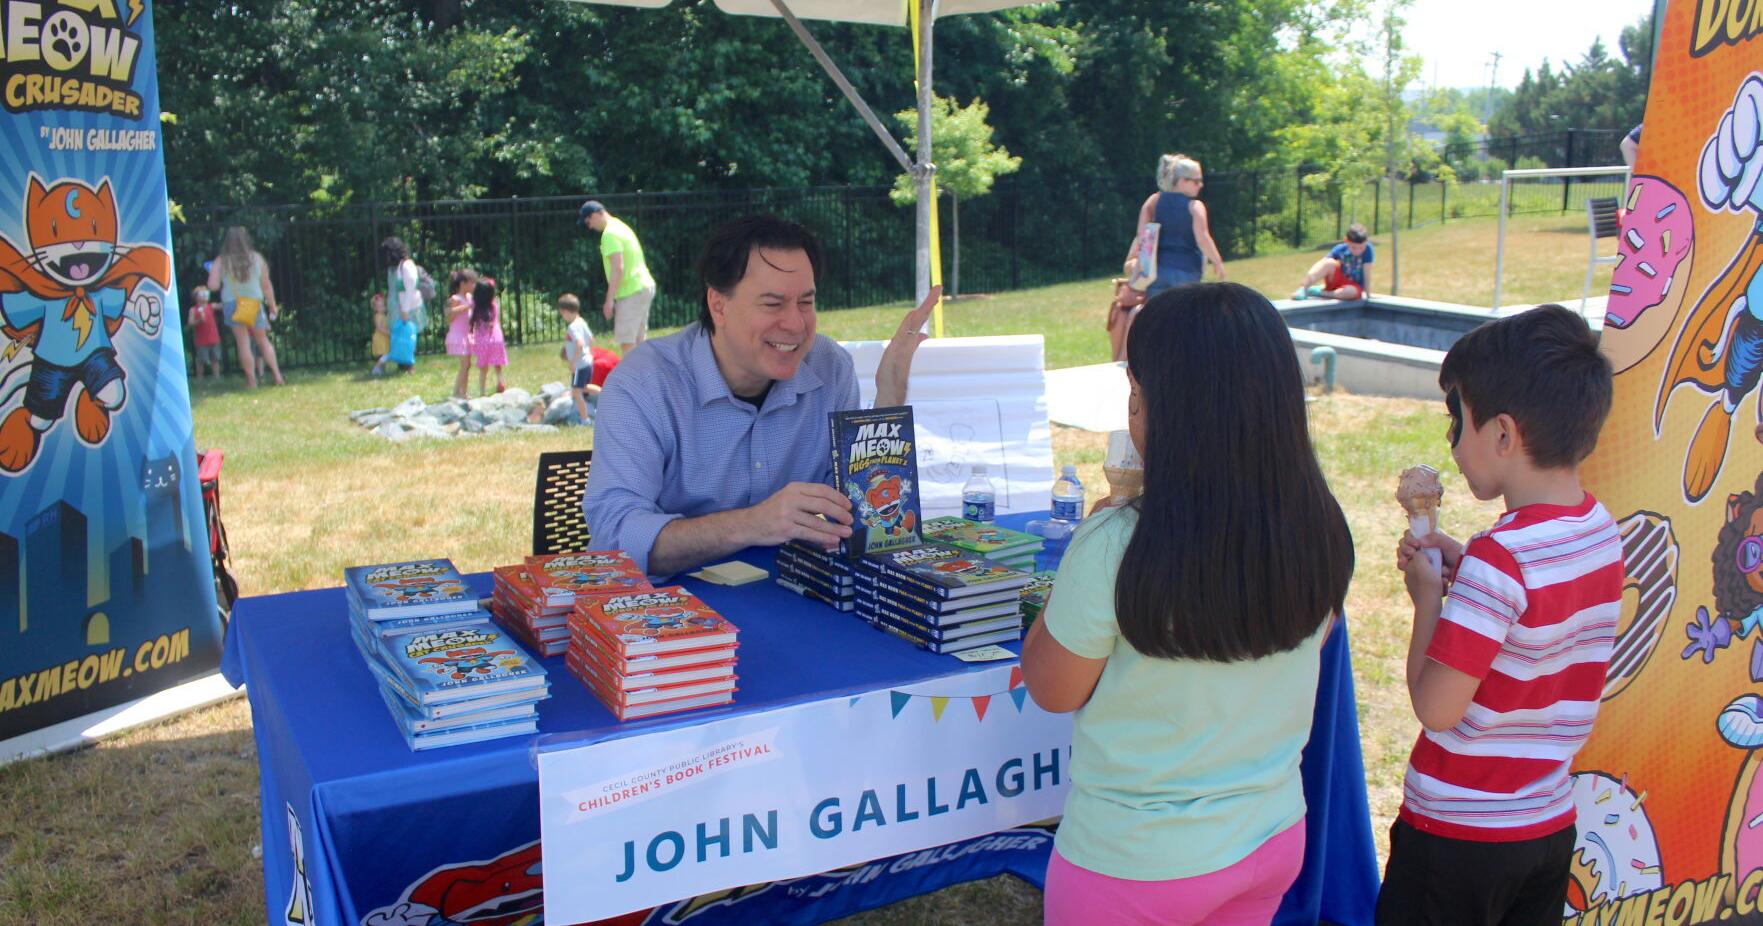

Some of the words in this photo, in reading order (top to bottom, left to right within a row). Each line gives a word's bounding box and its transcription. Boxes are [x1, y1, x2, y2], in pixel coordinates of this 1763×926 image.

[0, 1, 139, 81] EOW
[6, 73, 140, 116] CRUSADER
[40, 126, 50, 138] BY
[49, 126, 84, 150] JOHN
[86, 127, 156, 151] GALLAGHER
[855, 423, 902, 441] MAX
[849, 438, 906, 464] MEOW
[374, 563, 436, 574] MAX
[544, 559, 617, 570] MEOW
[552, 555, 609, 564] MAX
[366, 567, 441, 581] MEOW
[602, 596, 679, 613] MEOW
[608, 592, 671, 605] MAX
[406, 634, 489, 654] MEOW
[412, 629, 481, 645] MAX
[441, 678, 468, 687] JOHN
[471, 669, 528, 682] GALLAGHER
[602, 780, 628, 793] CECIL
[631, 768, 667, 785] COUNTY
[669, 755, 700, 772] PUBLIC
[702, 741, 745, 761] LIBRARY'S
[578, 778, 661, 812] CHILDREN'S
[666, 764, 704, 785] BOOK
[708, 743, 771, 769] FESTIVAL
[615, 809, 778, 883] JOHN
[809, 745, 1072, 840] GALLAGH
[889, 836, 1048, 874] GALLAGHER
